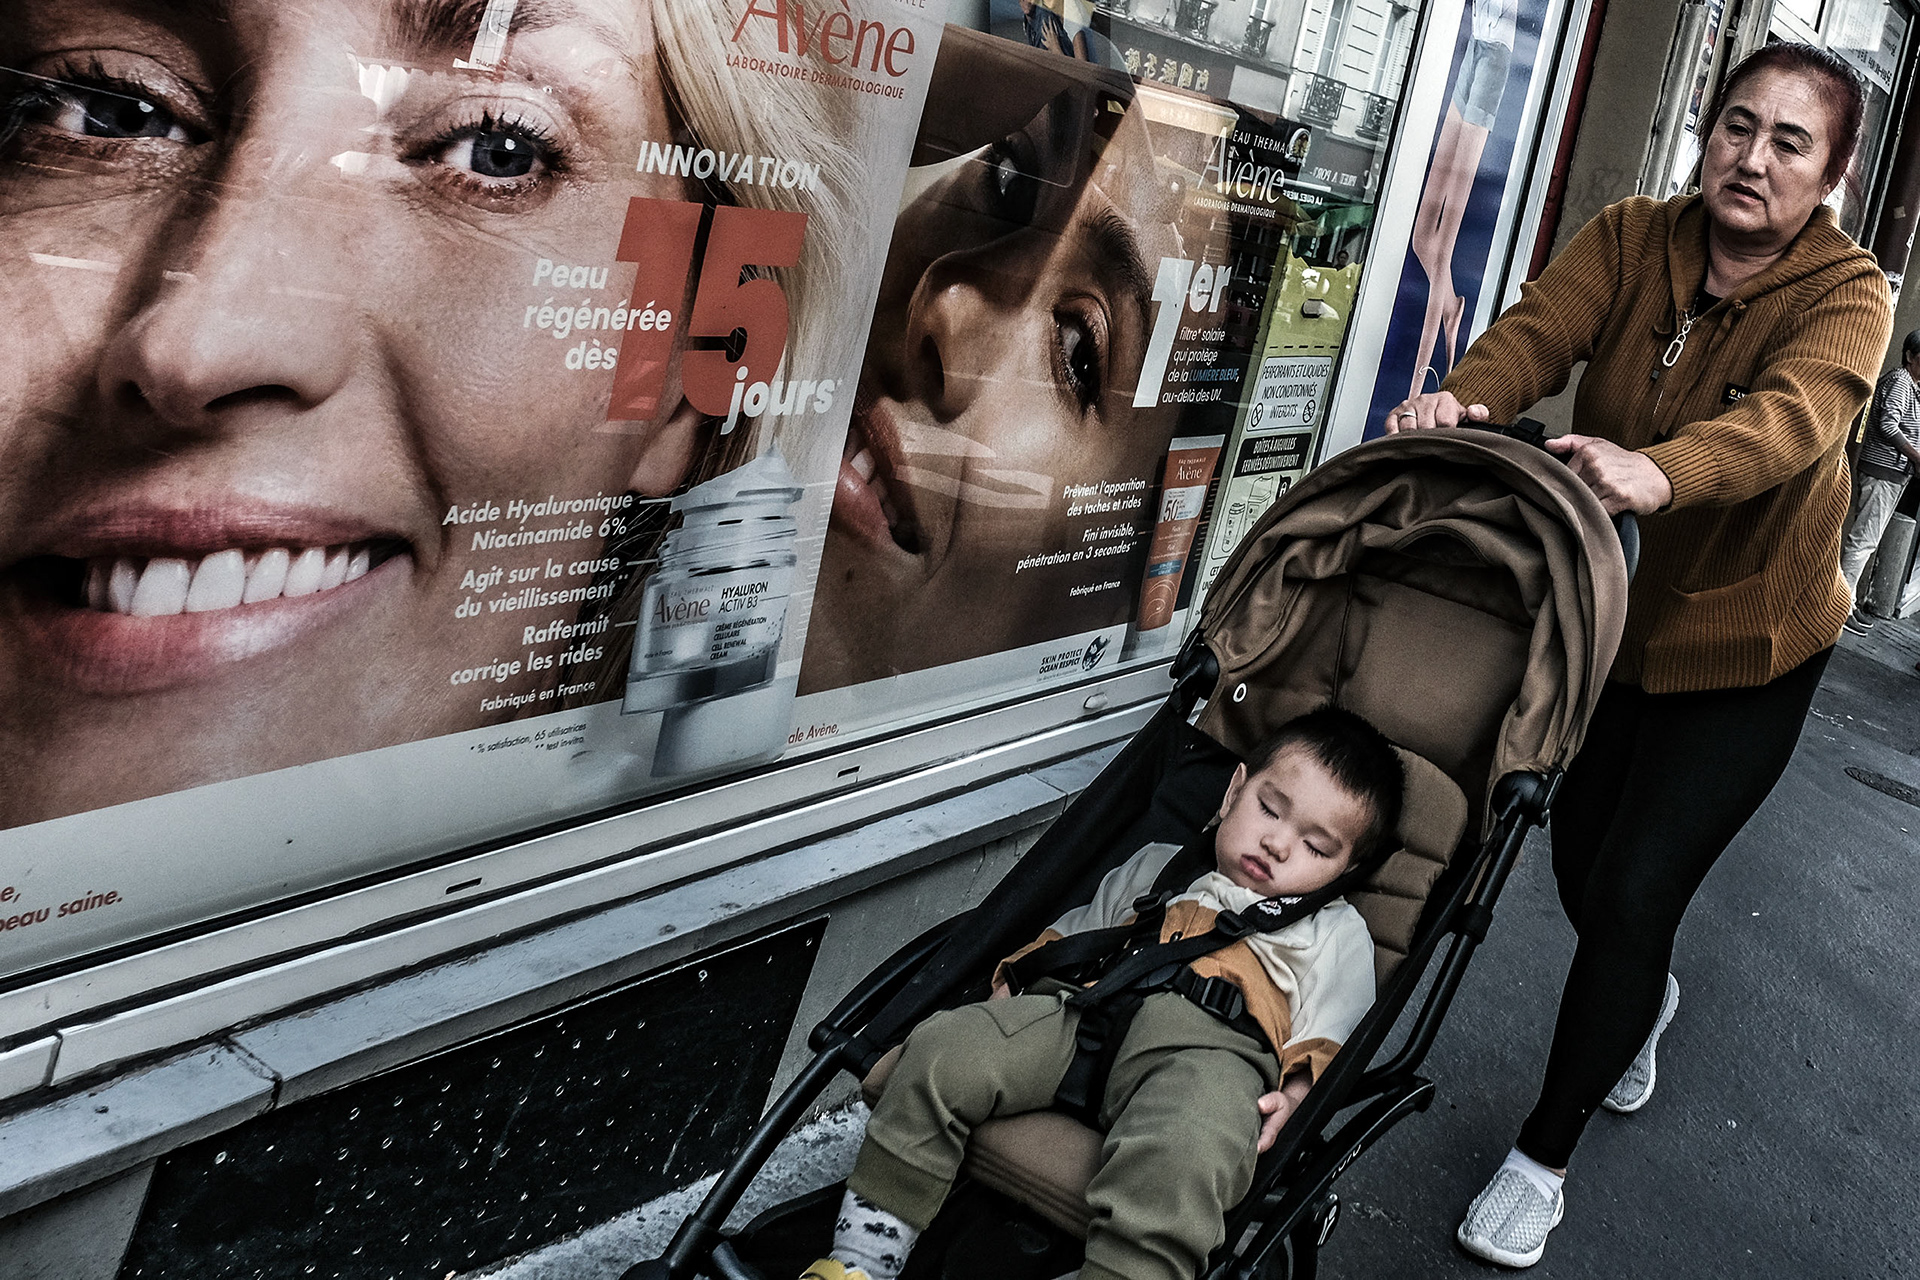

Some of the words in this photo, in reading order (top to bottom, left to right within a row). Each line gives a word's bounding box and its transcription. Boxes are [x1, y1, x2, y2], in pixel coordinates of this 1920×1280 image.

[731, 0, 915, 78] Avène
[726, 54, 808, 81] LABORATOIRE
[811, 71, 904, 99] DERMATOLOGIQUE
[1232, 130, 1250, 145] EAU
[1253, 135, 1290, 155] THERMA
[636, 141, 821, 191] INNOVATION
[1197, 126, 1285, 204] Avène
[1194, 196, 1229, 212] LABORATOIRE
[1230, 202, 1276, 219] DERMATOLOGIQUE
[532, 258, 609, 290] Peau
[523, 300, 672, 339] régénérée
[606, 196, 809, 421] 15
[1132, 256, 1232, 408] 1er
[1201, 327, 1226, 342] solaire
[565, 338, 618, 370] dès
[1173, 347, 1189, 366] qui
[1186, 347, 1218, 366] protège
[1167, 368, 1180, 382] de
[1180, 368, 1189, 382] la
[1188, 365, 1220, 382] LUMIÈRE
[1162, 388, 1196, 403] au-delà
[1195, 388, 1210, 402] des
[1210, 388, 1222, 402] UV.
[1262, 385, 1276, 400] NON
[1175, 465, 1202, 480] Avène
[1062, 482, 1098, 499] Prévient
[1099, 477, 1146, 498] l'apparition
[442, 501, 500, 526] Acide
[505, 491, 633, 524] Hyaluronique
[1067, 502, 1082, 517] des
[1084, 499, 1110, 514] taches
[1112, 499, 1121, 511] et
[1121, 494, 1142, 510] rides
[471, 519, 594, 551] Niacinamide
[598, 517, 627, 538] 6%
[1082, 527, 1098, 543] Fini
[1099, 522, 1135, 540] invisible,
[1015, 550, 1071, 574] pénétration
[1072, 551, 1084, 562] en
[1085, 545, 1094, 560] 3
[459, 565, 503, 593] Agit
[508, 566, 540, 584] sur
[544, 558, 564, 579] la
[568, 557, 620, 576] cause
[721, 581, 769, 600] HYALURON
[1069, 583, 1095, 597] Fabriqué
[1095, 584, 1102, 592] en
[1103, 580, 1121, 592] France
[455, 596, 482, 619] du
[650, 593, 710, 625] Avène
[718, 597, 747, 613] ACTIV
[746, 595, 758, 609] B3
[522, 614, 610, 646] Raffermit
[450, 657, 521, 685] corrige
[527, 650, 554, 673] les
[558, 642, 604, 667] rides
[1039, 662, 1058, 675] OCEAN
[1059, 657, 1081, 669] RESPECT
[1041, 654, 1056, 665] SKIN
[1058, 648, 1083, 661] PROTECT
[479, 689, 536, 712] Fabriqué
[539, 689, 554, 701] en
[557, 680, 596, 698] France
[534, 729, 546, 741] 65
[547, 723, 587, 739] utilisatrices
[805, 722, 840, 740] Avène,
[57, 889, 124, 918] saine.
